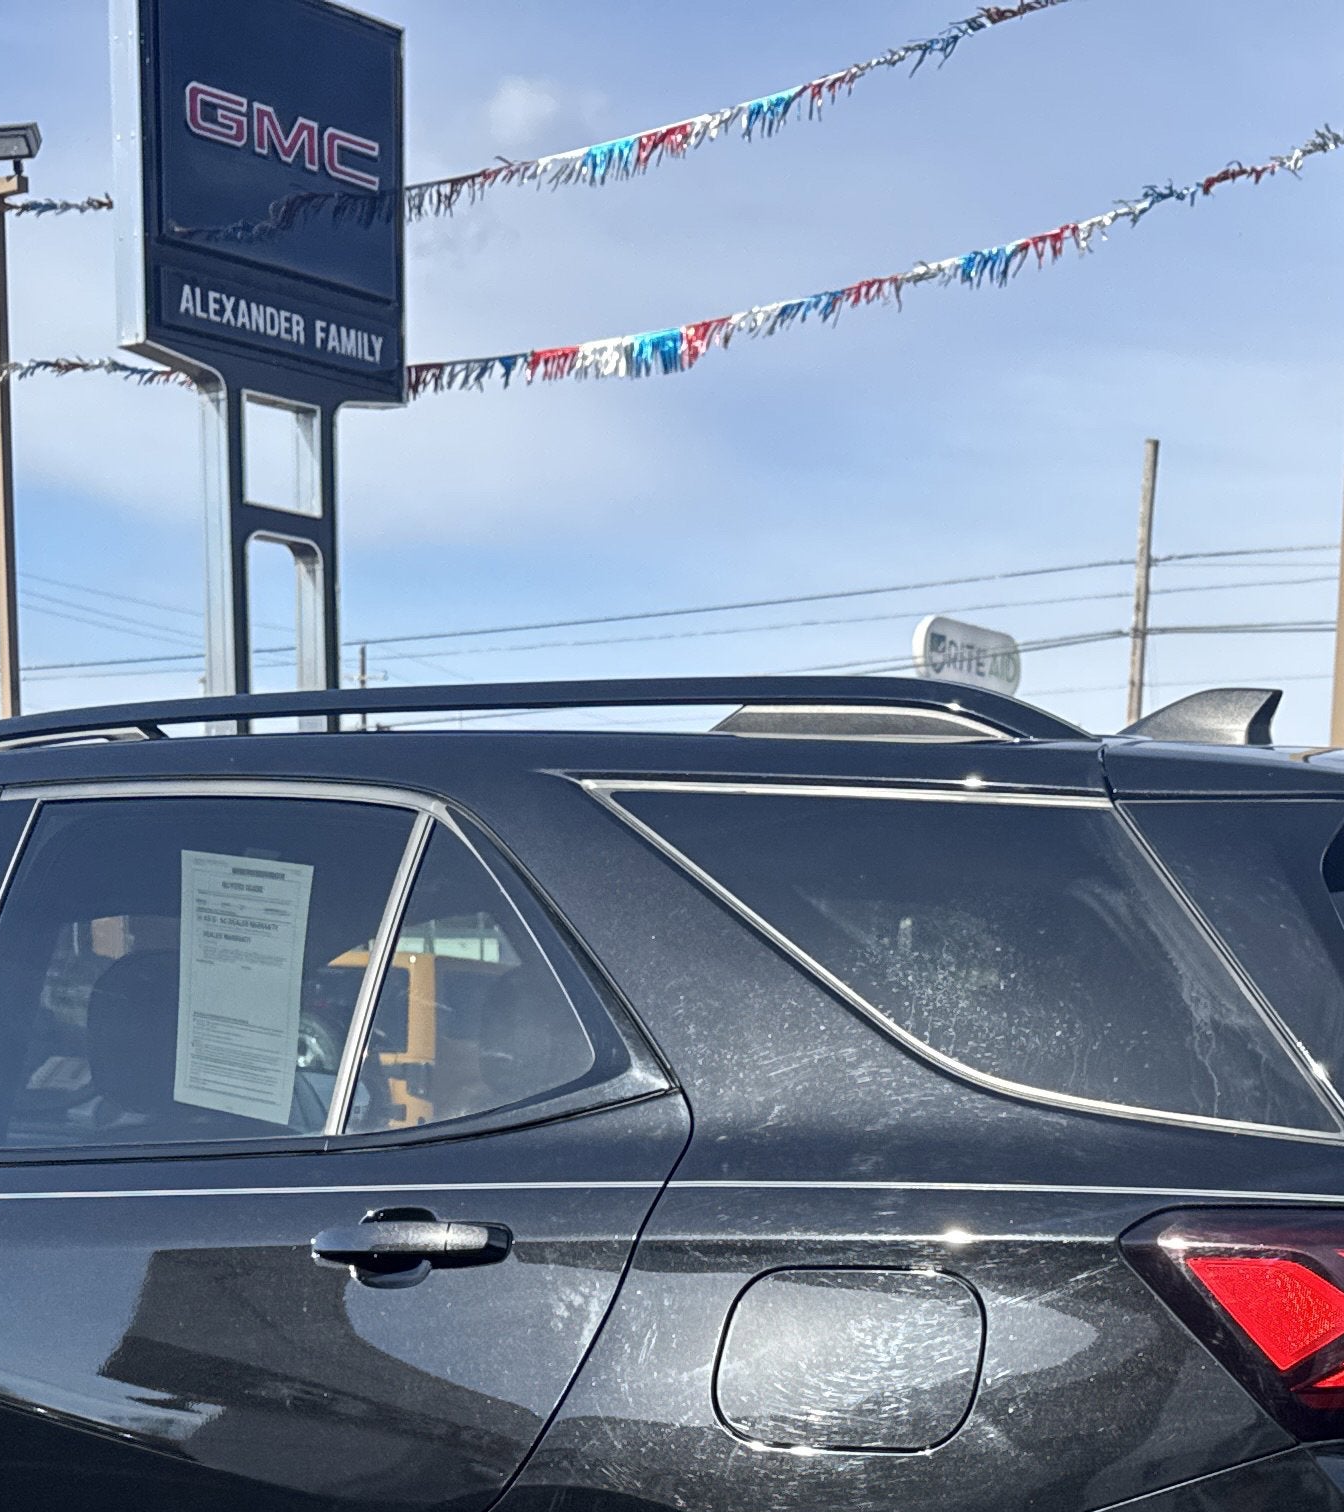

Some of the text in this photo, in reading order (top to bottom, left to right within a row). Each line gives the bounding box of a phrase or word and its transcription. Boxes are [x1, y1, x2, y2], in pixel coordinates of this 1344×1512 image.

[185, 81, 379, 191] GMC
[179, 284, 383, 365] ALEXANDER FAMILY
